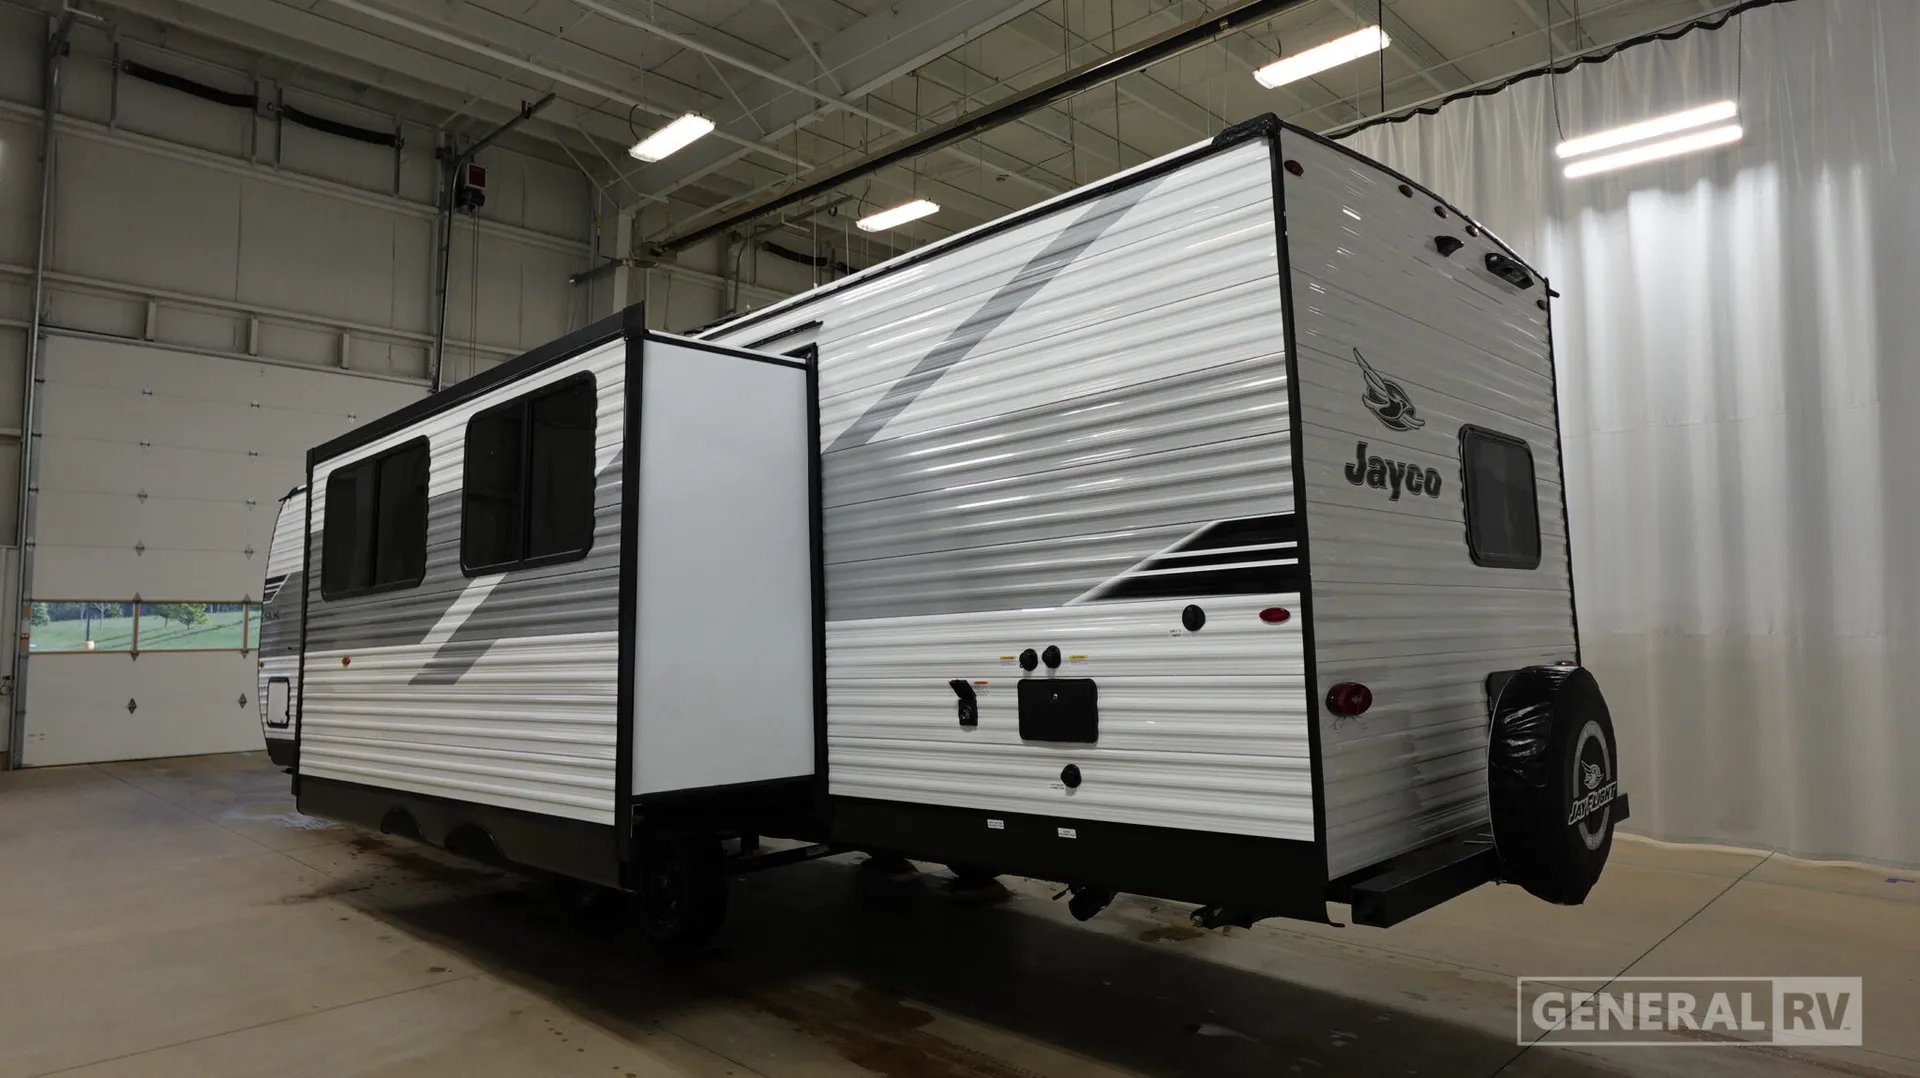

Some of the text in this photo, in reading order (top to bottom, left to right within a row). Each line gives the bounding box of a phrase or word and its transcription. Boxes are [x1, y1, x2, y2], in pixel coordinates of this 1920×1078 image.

[1345, 441, 1442, 501] Jayco
[1568, 781, 1618, 825] JAY FLIGHT
